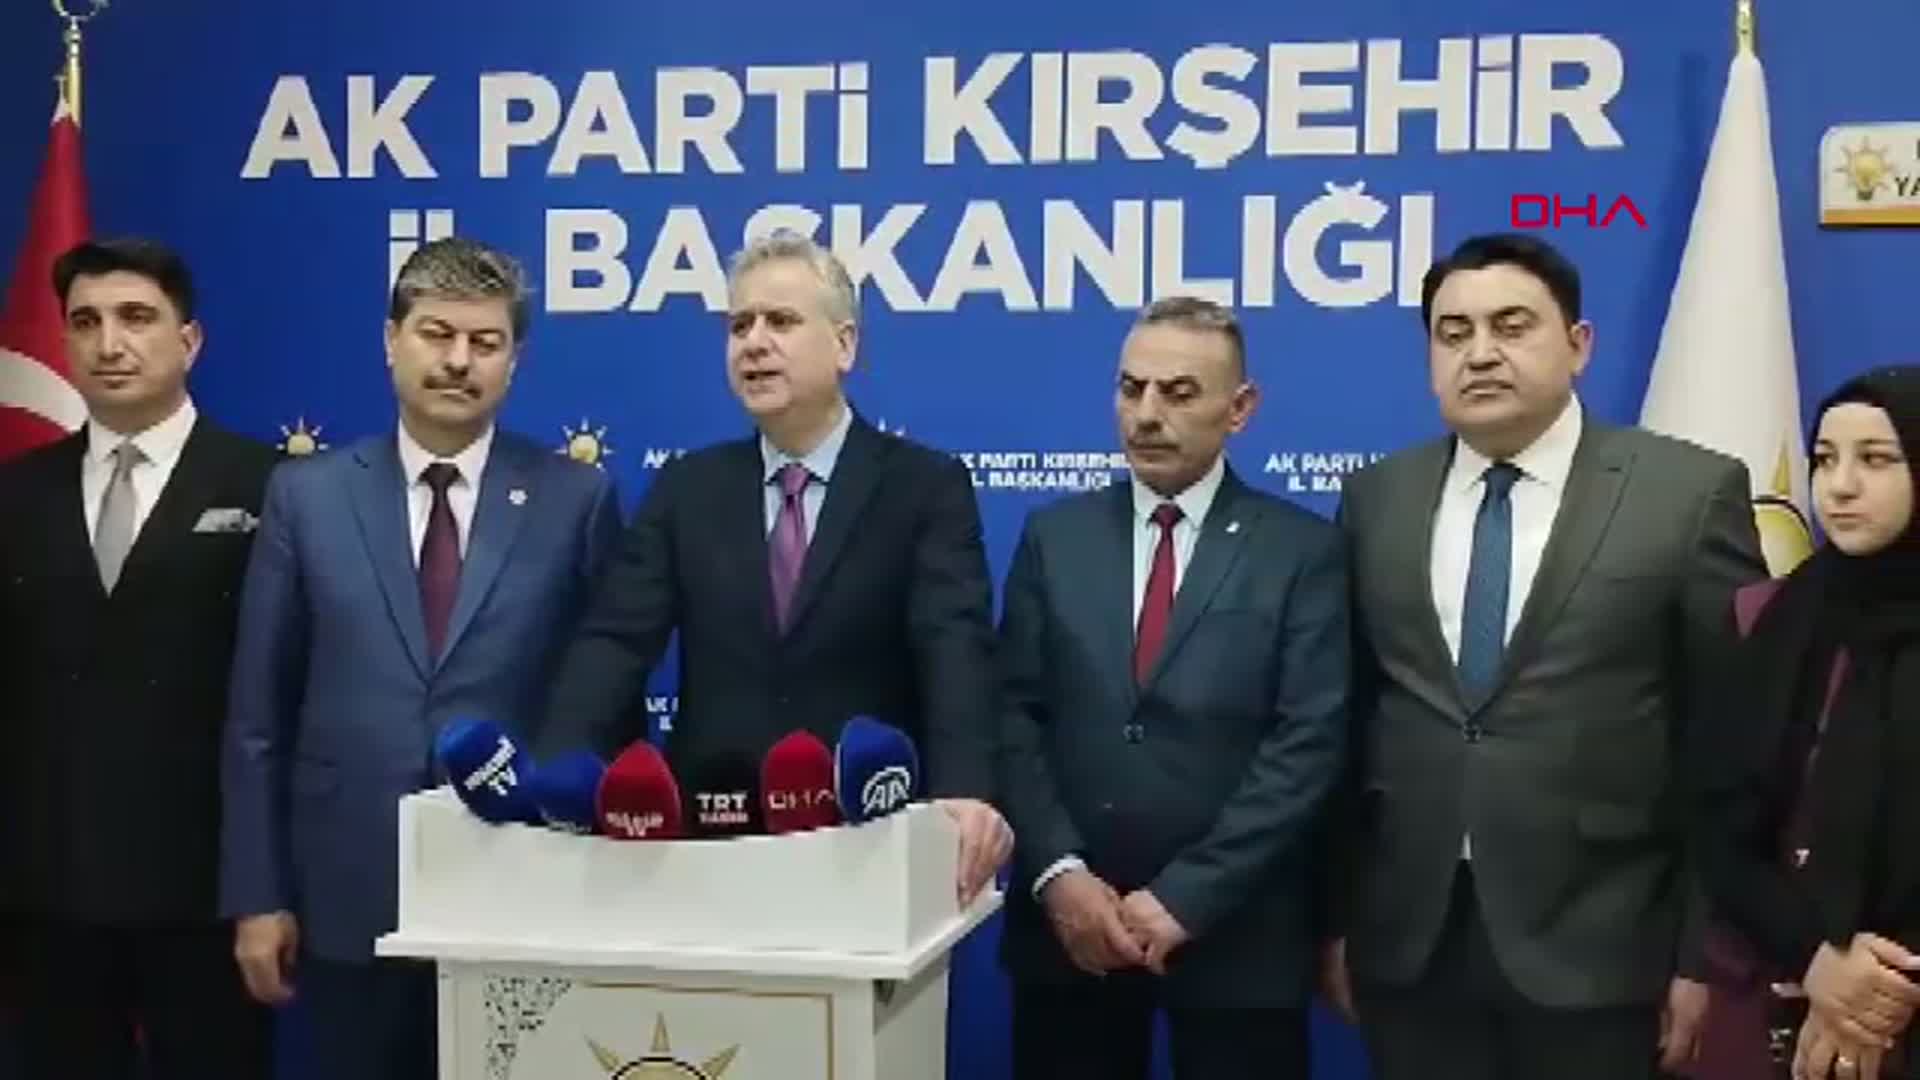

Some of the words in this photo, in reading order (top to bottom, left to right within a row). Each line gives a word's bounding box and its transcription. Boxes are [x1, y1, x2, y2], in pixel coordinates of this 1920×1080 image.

[240, 74, 438, 179] AK
[478, 62, 869, 179] PARTİ
[922, 33, 1625, 170] KIRŞEHİR
[544, 179, 1436, 314] BAKANLIĞI
[1263, 452, 1298, 473] AK
[695, 790, 749, 810] TRT
